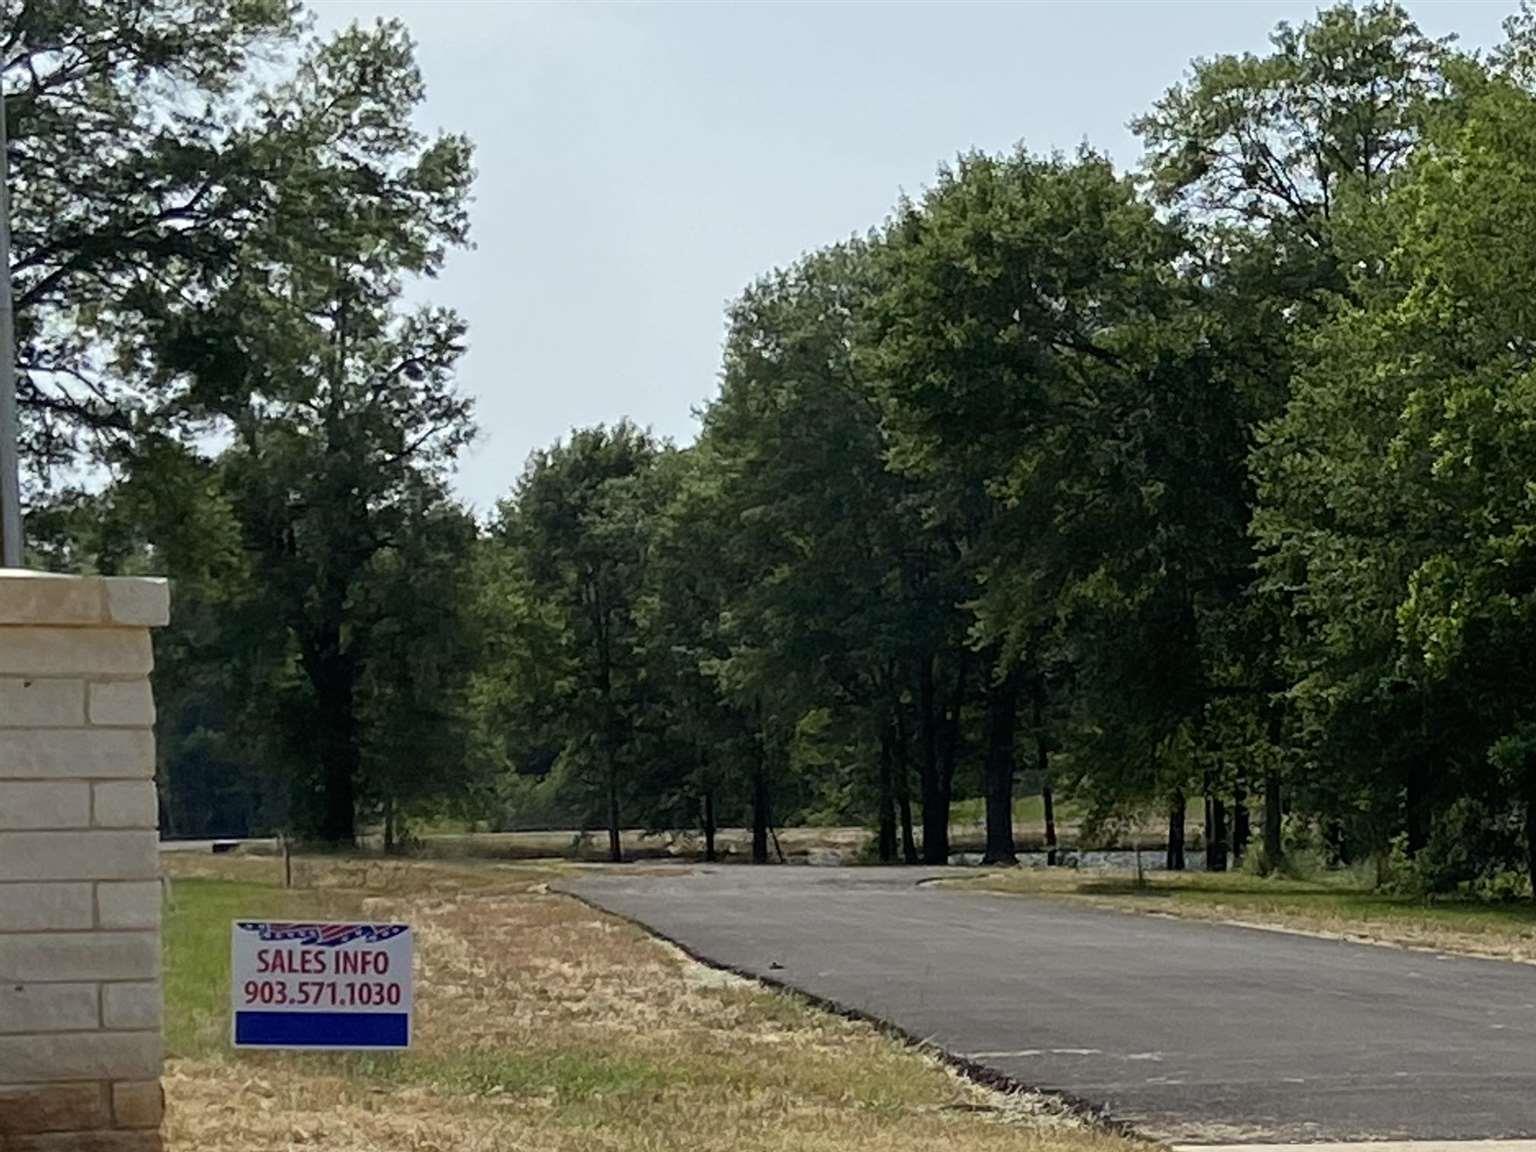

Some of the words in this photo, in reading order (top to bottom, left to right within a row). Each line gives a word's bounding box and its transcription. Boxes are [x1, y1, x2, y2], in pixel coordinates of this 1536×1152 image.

[257, 949, 326, 974] SALES
[334, 951, 389, 975] INFO
[244, 981, 401, 1006] 903.571.1030
